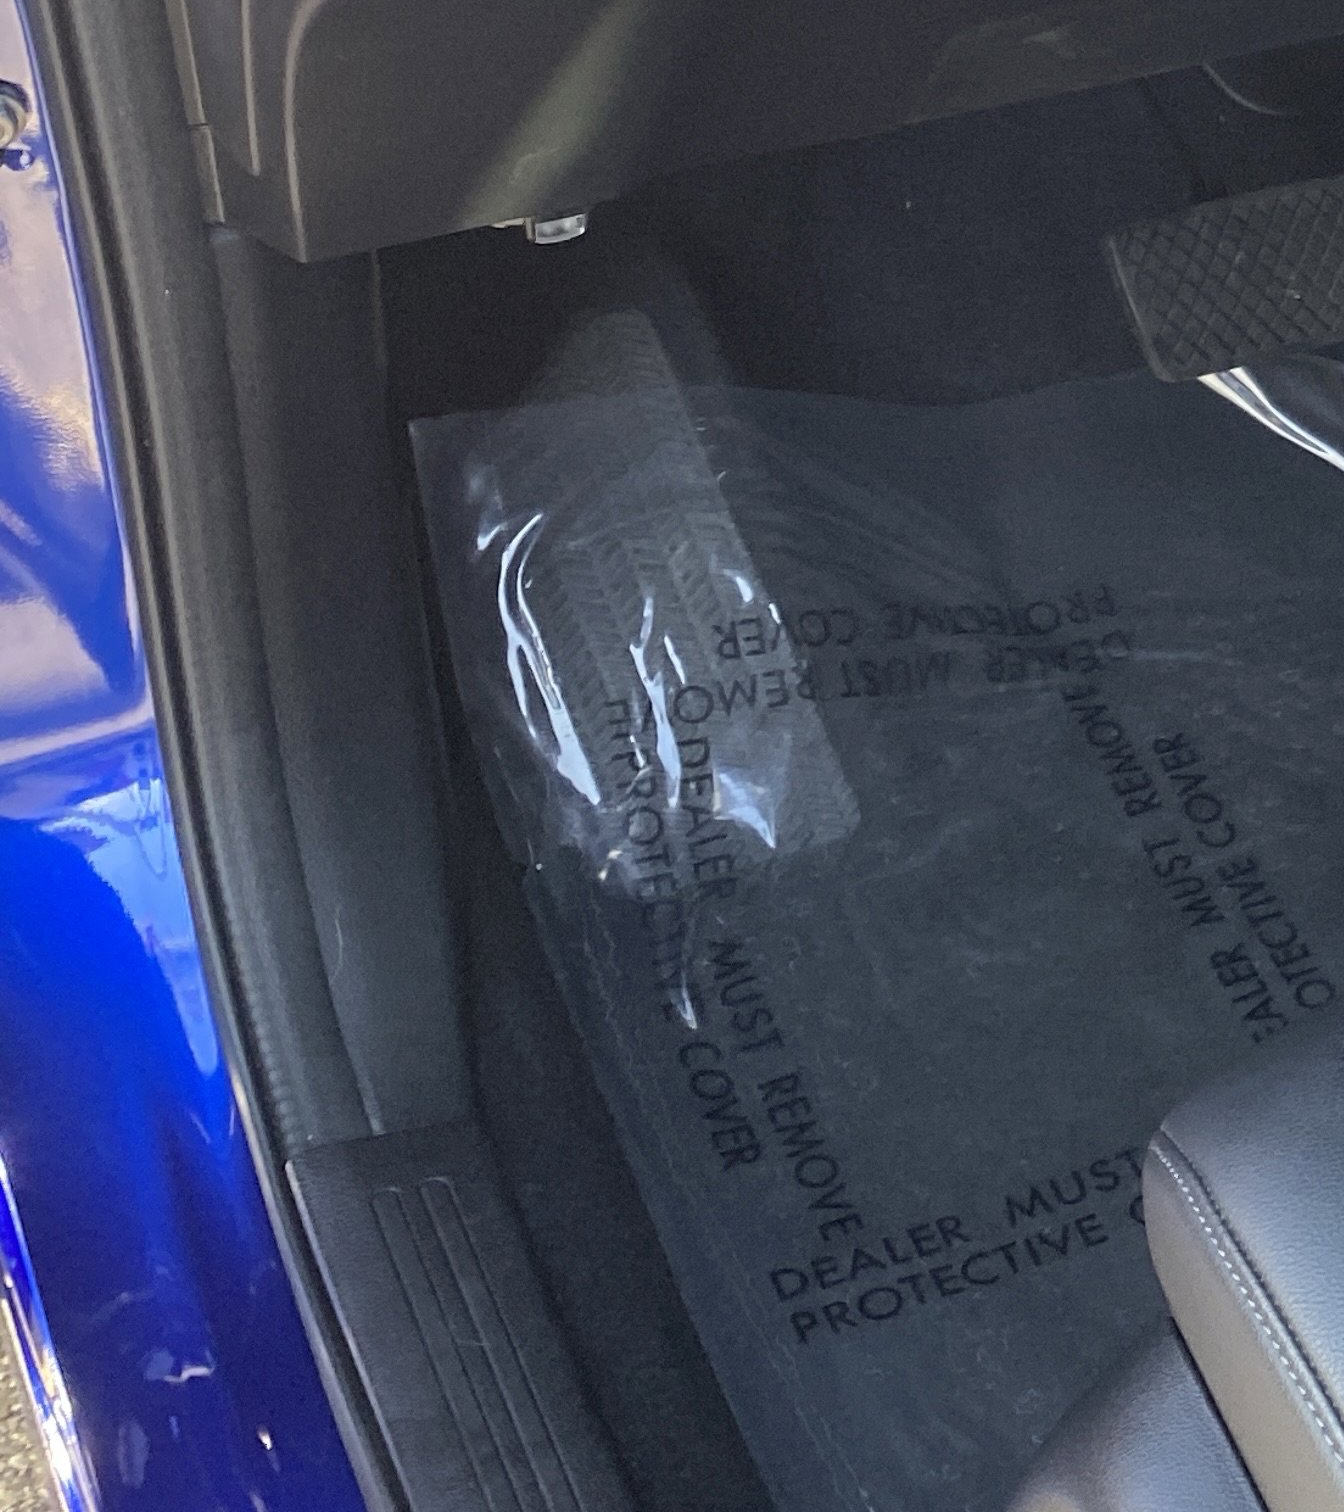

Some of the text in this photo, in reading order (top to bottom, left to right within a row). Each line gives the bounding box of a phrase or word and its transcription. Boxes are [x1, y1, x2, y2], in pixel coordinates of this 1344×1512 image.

[1057, 686, 1164, 819] REMOVE
[1151, 731, 1238, 850] COVER
[1140, 837, 1227, 929] MUST
[676, 1039, 764, 1173] COVER
[707, 940, 786, 1054] MUST
[756, 1070, 867, 1243] REMOVE
[768, 1145, 1144, 1303] DEALER MUST
[788, 1211, 1111, 1346] PROTECTIVE
